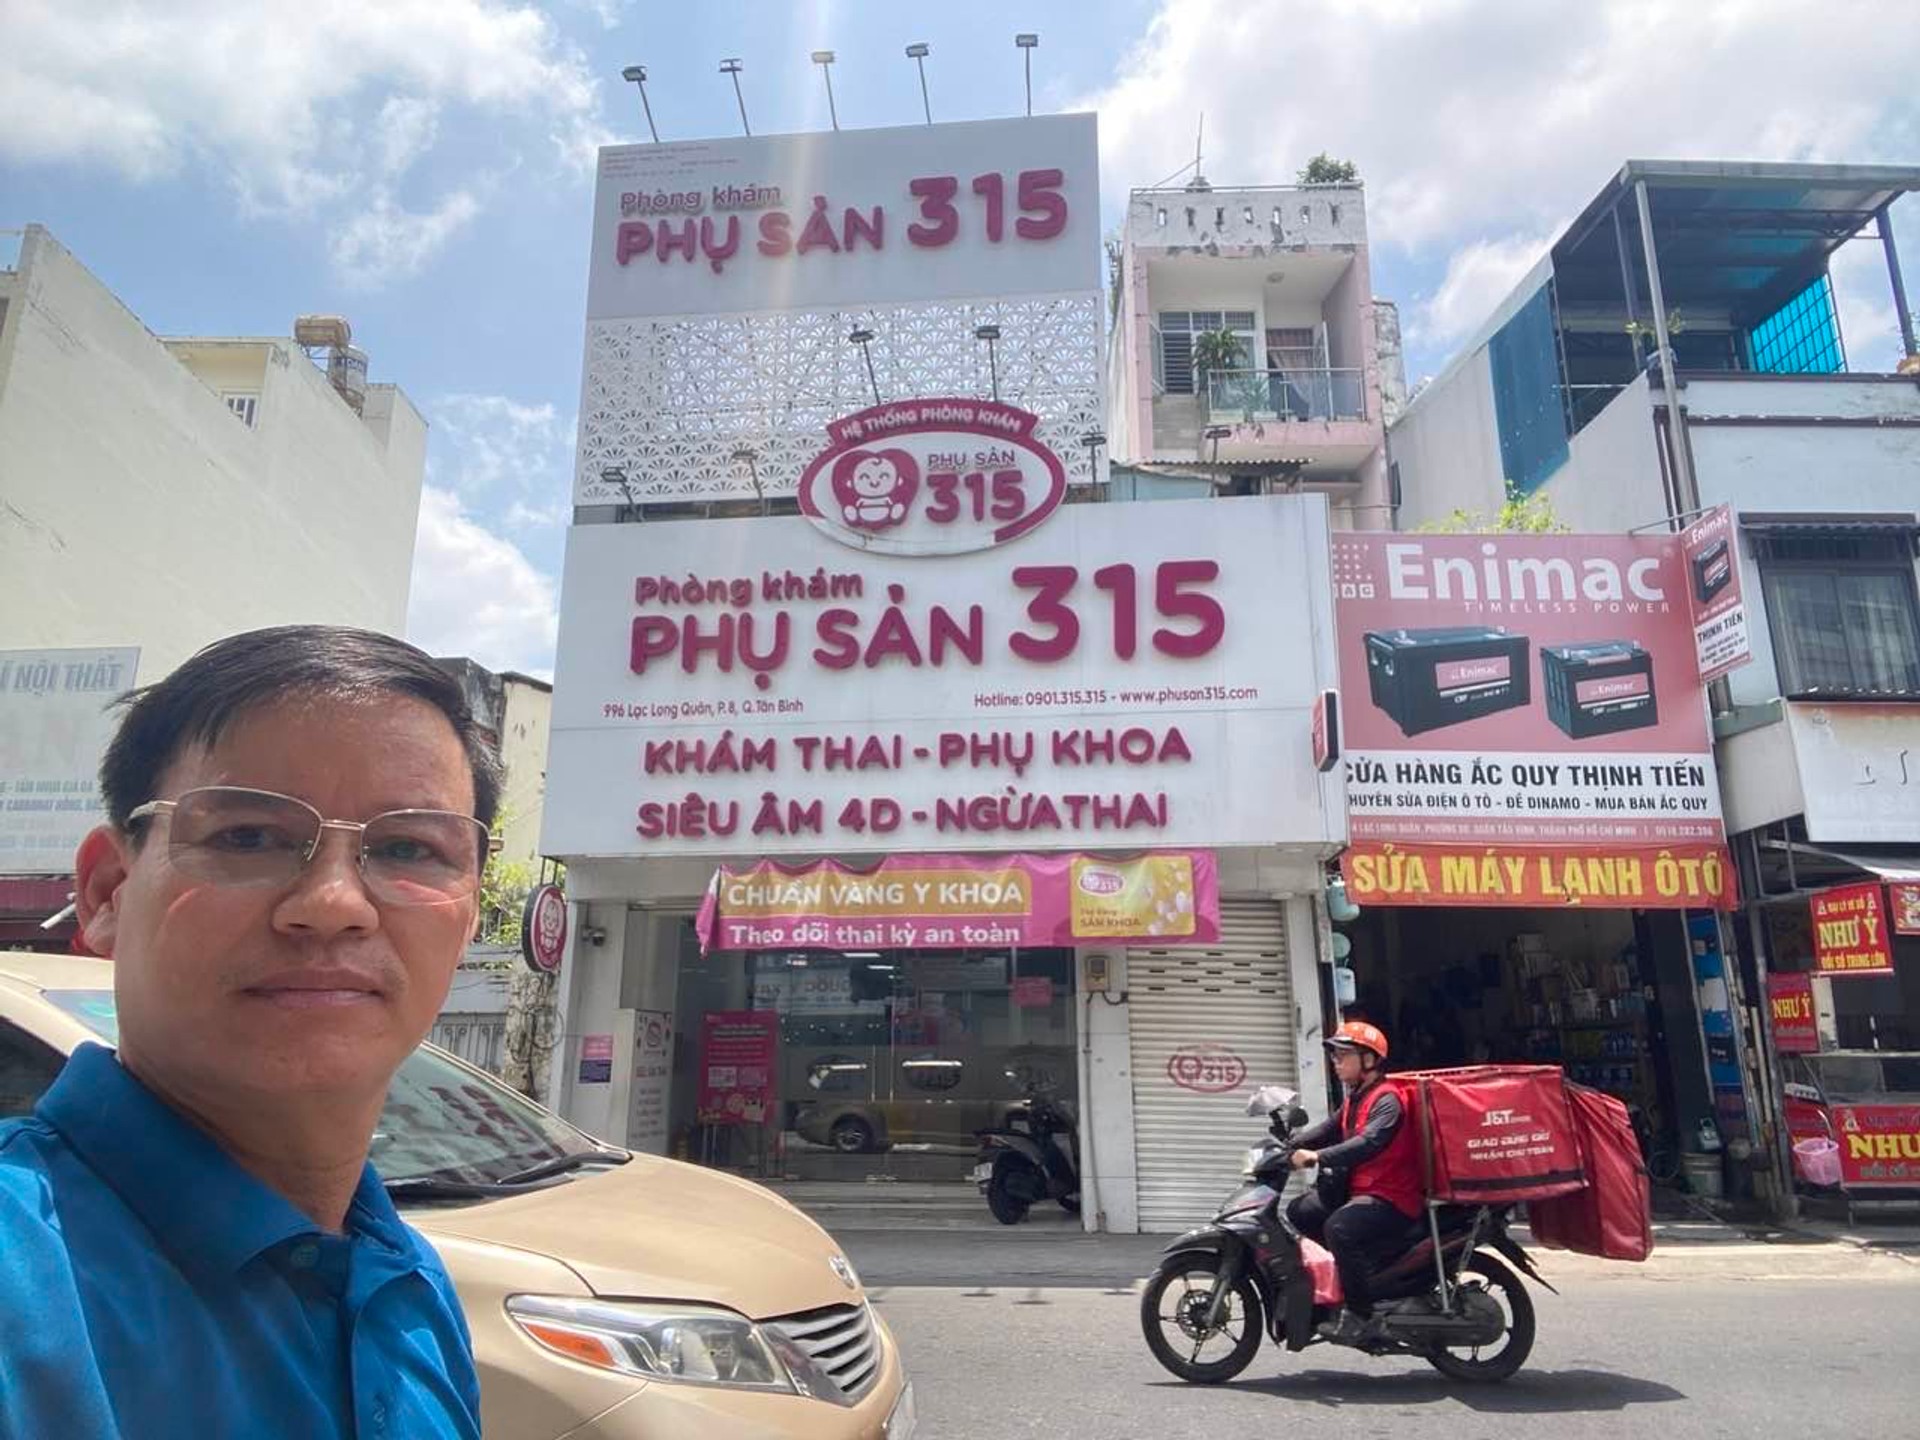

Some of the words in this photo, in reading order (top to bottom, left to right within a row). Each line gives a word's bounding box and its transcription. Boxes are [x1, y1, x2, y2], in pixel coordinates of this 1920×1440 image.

[621, 188, 702, 213] Phòng
[712, 184, 782, 205] khám
[617, 214, 740, 274] PHỤ
[757, 196, 885, 255] SẢN
[907, 168, 1068, 247] 315
[921, 404, 974, 423] PHÒNG
[975, 447, 1016, 464] SẢN
[925, 470, 1026, 523] 315
[1691, 512, 1729, 544] Enimac
[635, 573, 754, 608] Phòng
[762, 567, 863, 601] khám
[1385, 542, 1665, 602] Enimac
[1463, 601, 1577, 614] TIMELESS
[1594, 601, 1671, 614] POWER
[630, 611, 791, 691] PHỤ
[813, 584, 983, 670] SẢN
[1008, 560, 1225, 662] 315
[14, 659, 58, 696] NỘI
[604, 704, 625, 718] 996
[628, 703, 648, 719] Lạc
[651, 703, 678, 719] Long
[974, 691, 1023, 708] Hotline:
[1025, 690, 1106, 706] 0901.315.315
[1120, 686, 1258, 704] www.phusan315.com
[644, 729, 776, 774] KHÁM
[793, 734, 902, 772] THAI
[939, 732, 1034, 777] PHỤ
[1052, 726, 1191, 766] KHOA
[1396, 758, 1462, 785] HÀNG
[1471, 756, 1502, 785] ẮC
[1512, 764, 1559, 787] QUY
[1568, 765, 1643, 791] THỊNH
[1650, 759, 1705, 786] TIẾN
[636, 792, 739, 839] SIÊU
[751, 791, 823, 836] ÂM
[838, 798, 902, 834] 4D
[1397, 790, 1422, 807] SỬA
[1426, 794, 1457, 809] ĐIỆN
[1528, 796, 1580, 810] DINAMO
[1595, 797, 1625, 810] MUA
[1630, 794, 1656, 810] BÁN
[1682, 798, 1708, 811] QUY
[1352, 843, 1430, 893] SỬA
[1441, 848, 1526, 894] MÁY
[1539, 856, 1643, 904] LẠNH
[913, 882, 931, 904] Y
[940, 881, 1024, 906] KHOA
[728, 925, 785, 944] Theo
[792, 921, 830, 943] dõi
[836, 925, 883, 944] thai
[890, 924, 915, 947] kỳ
[925, 929, 955, 944] an
[961, 923, 1020, 943] toàn
[1818, 914, 1860, 949] NHƯ
[1863, 911, 1878, 945] Ý
[1772, 995, 1799, 1018] NHƯ
[1203, 1065, 1237, 1083] 315
